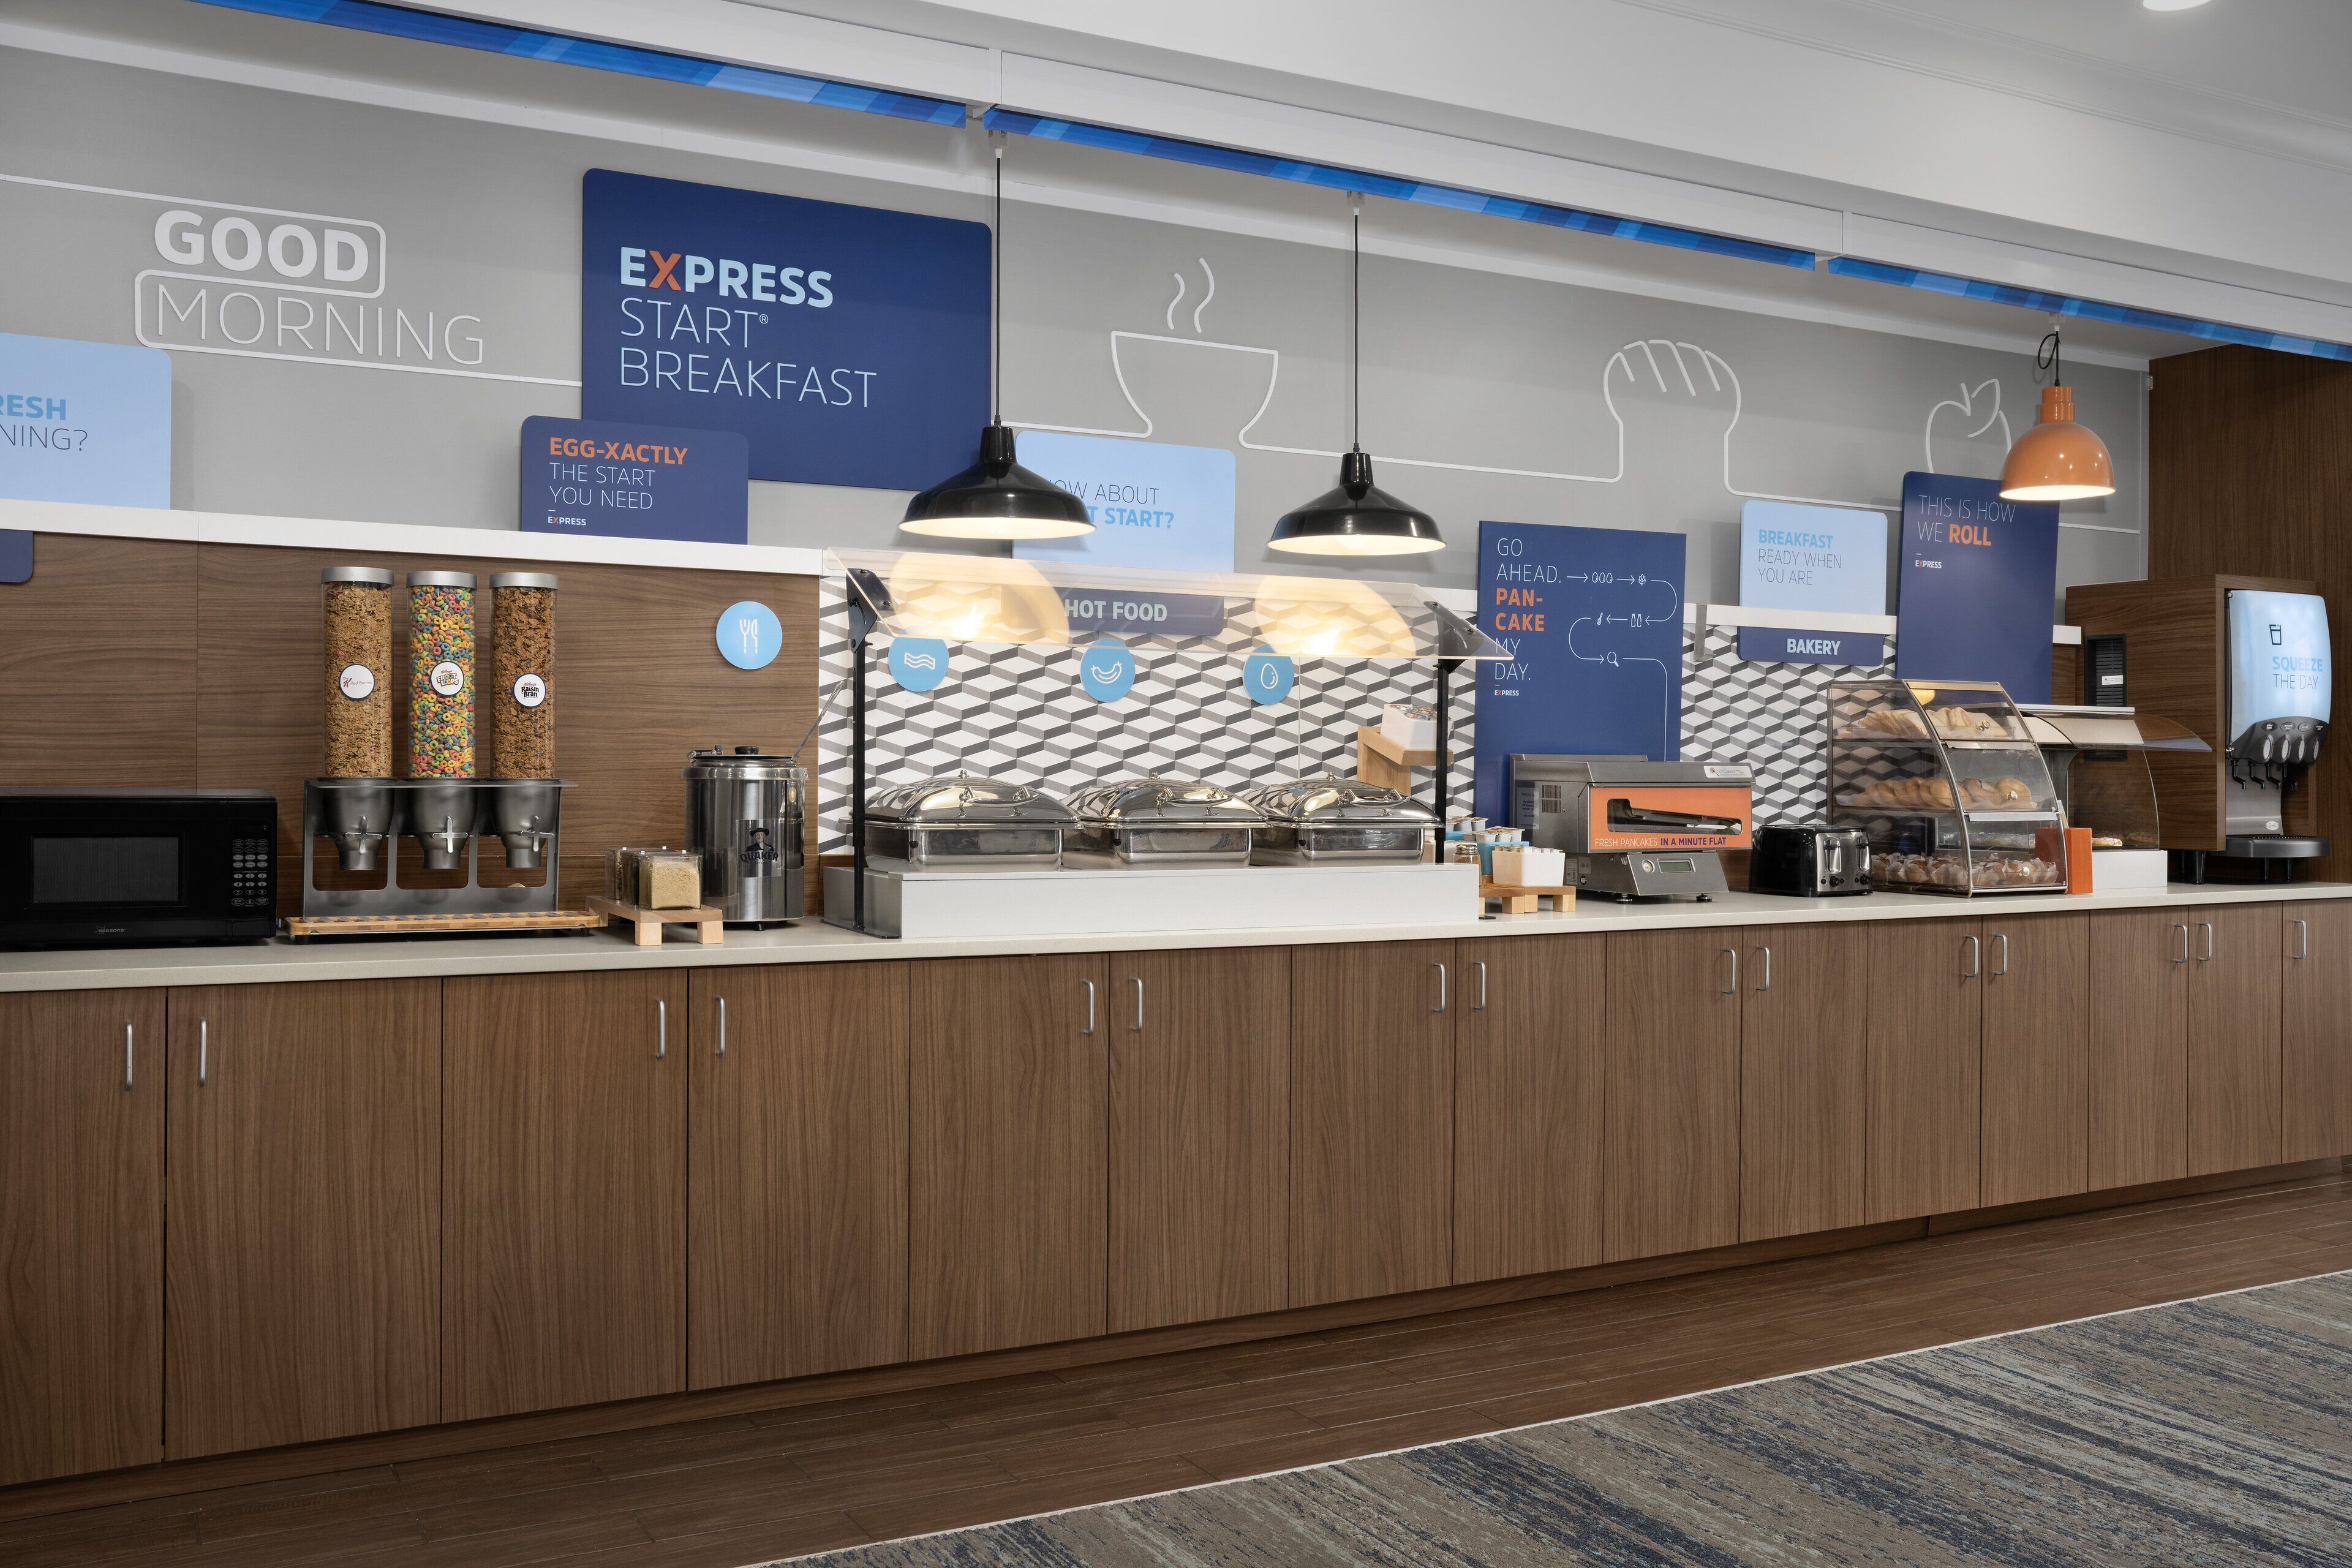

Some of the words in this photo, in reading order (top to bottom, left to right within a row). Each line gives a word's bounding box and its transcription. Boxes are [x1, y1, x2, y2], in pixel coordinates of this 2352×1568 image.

[154, 210, 369, 282] GOOD
[620, 246, 834, 308] EXPRESS
[159, 284, 483, 364] MORNING
[621, 347, 877, 408] BREAKFAST
[0, 394, 66, 421] ESH
[550, 437, 688, 465] EGG-XACTLY
[549, 462, 587, 482] THE
[596, 466, 655, 486] START
[549, 486, 592, 505] YOU
[601, 489, 653, 509] NEED
[1095, 484, 1159, 505] ABOUT
[1104, 507, 1175, 529] START?
[1918, 495, 1952, 517] THIS
[1959, 499, 1970, 519] IS
[1977, 501, 2016, 522] HOW
[548, 516, 587, 526] EXPRESS
[1758, 529, 1833, 549] BREAKFAST
[1917, 521, 1943, 542] WE
[1949, 524, 1992, 546] ROLL
[1498, 538, 1523, 556] GO
[1758, 548, 1800, 565] READY
[1804, 552, 1841, 568] WHEN
[1915, 560, 1942, 568] EXPRESS
[1496, 563, 1561, 583] AHEAD.
[1758, 567, 1784, 583] YOU
[1789, 570, 1813, 585] ARE
[1496, 587, 1543, 606] PAN-
[1065, 599, 1106, 619] HOT
[1112, 601, 1167, 622] FOOD
[1495, 612, 1545, 631] CAKE
[1496, 638, 1521, 655] MY
[1787, 638, 1841, 655] BAKERY
[1495, 663, 1531, 680] DAY.
[2272, 656, 2323, 673] SQUEEZE
[2272, 673, 2296, 689] THE
[2300, 675, 2319, 689] DAY
[1595, 838, 1618, 846] FRESH
[1621, 838, 1658, 846] PANCAKES
[1671, 837, 1676, 846] A
[1709, 837, 1727, 845] FLAT
[740, 852, 778, 862] QUAKER
